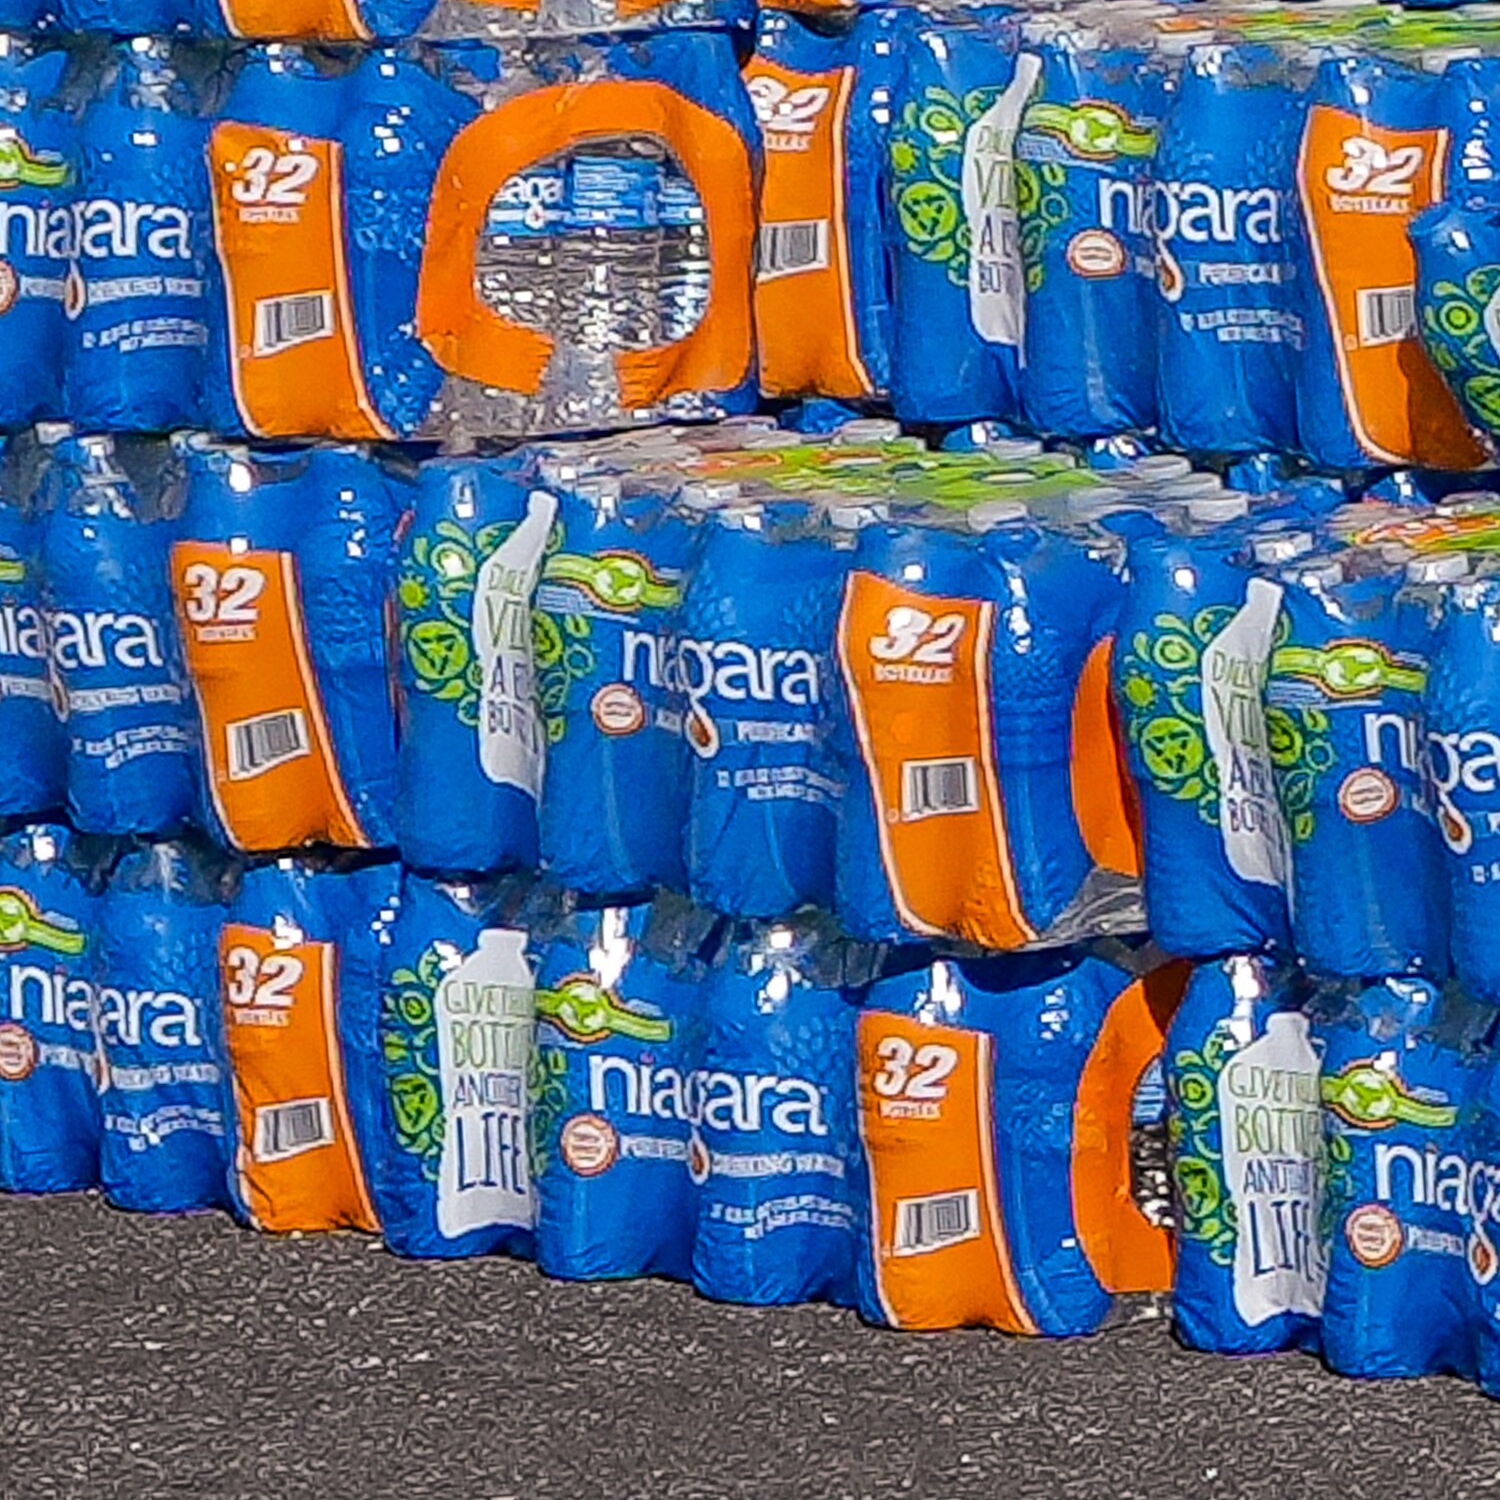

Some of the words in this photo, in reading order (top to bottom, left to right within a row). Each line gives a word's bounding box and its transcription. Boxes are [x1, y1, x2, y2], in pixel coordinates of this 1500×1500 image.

[746, 75, 832, 132] 32
[231, 147, 318, 204] 32
[1325, 135, 1425, 195] 32
[0, 198, 191, 291] niaara
[185, 563, 267, 622] 32
[0, 603, 164, 696] iaara
[869, 606, 965, 665] 32
[227, 945, 303, 1007] 32
[9, 962, 203, 1075] niaara
[872, 1037, 958, 1099] 32
[456, 1111, 526, 1195] LIFE
